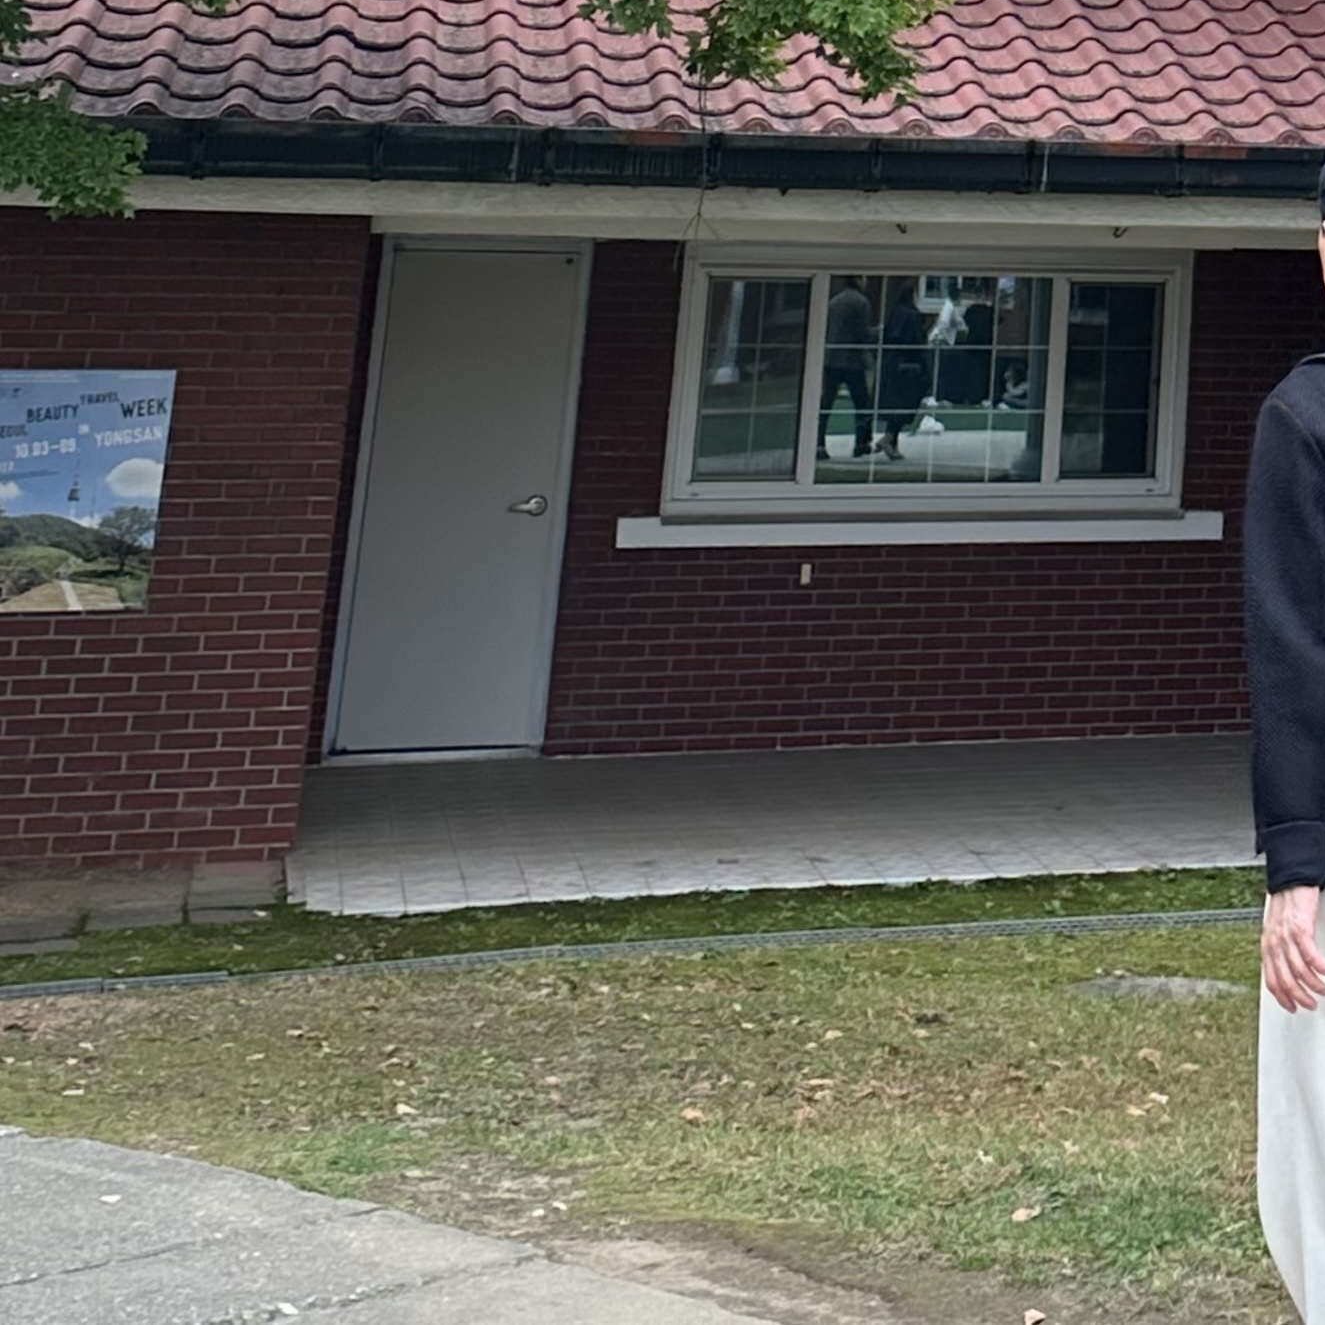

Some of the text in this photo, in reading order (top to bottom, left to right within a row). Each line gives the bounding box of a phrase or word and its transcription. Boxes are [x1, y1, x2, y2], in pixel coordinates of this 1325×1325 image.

[27, 404, 79, 423] BEAUTY
[80, 391, 120, 405] TRAVEL
[120, 397, 168, 419] WEEK
[94, 426, 163, 448] YONGSAN
